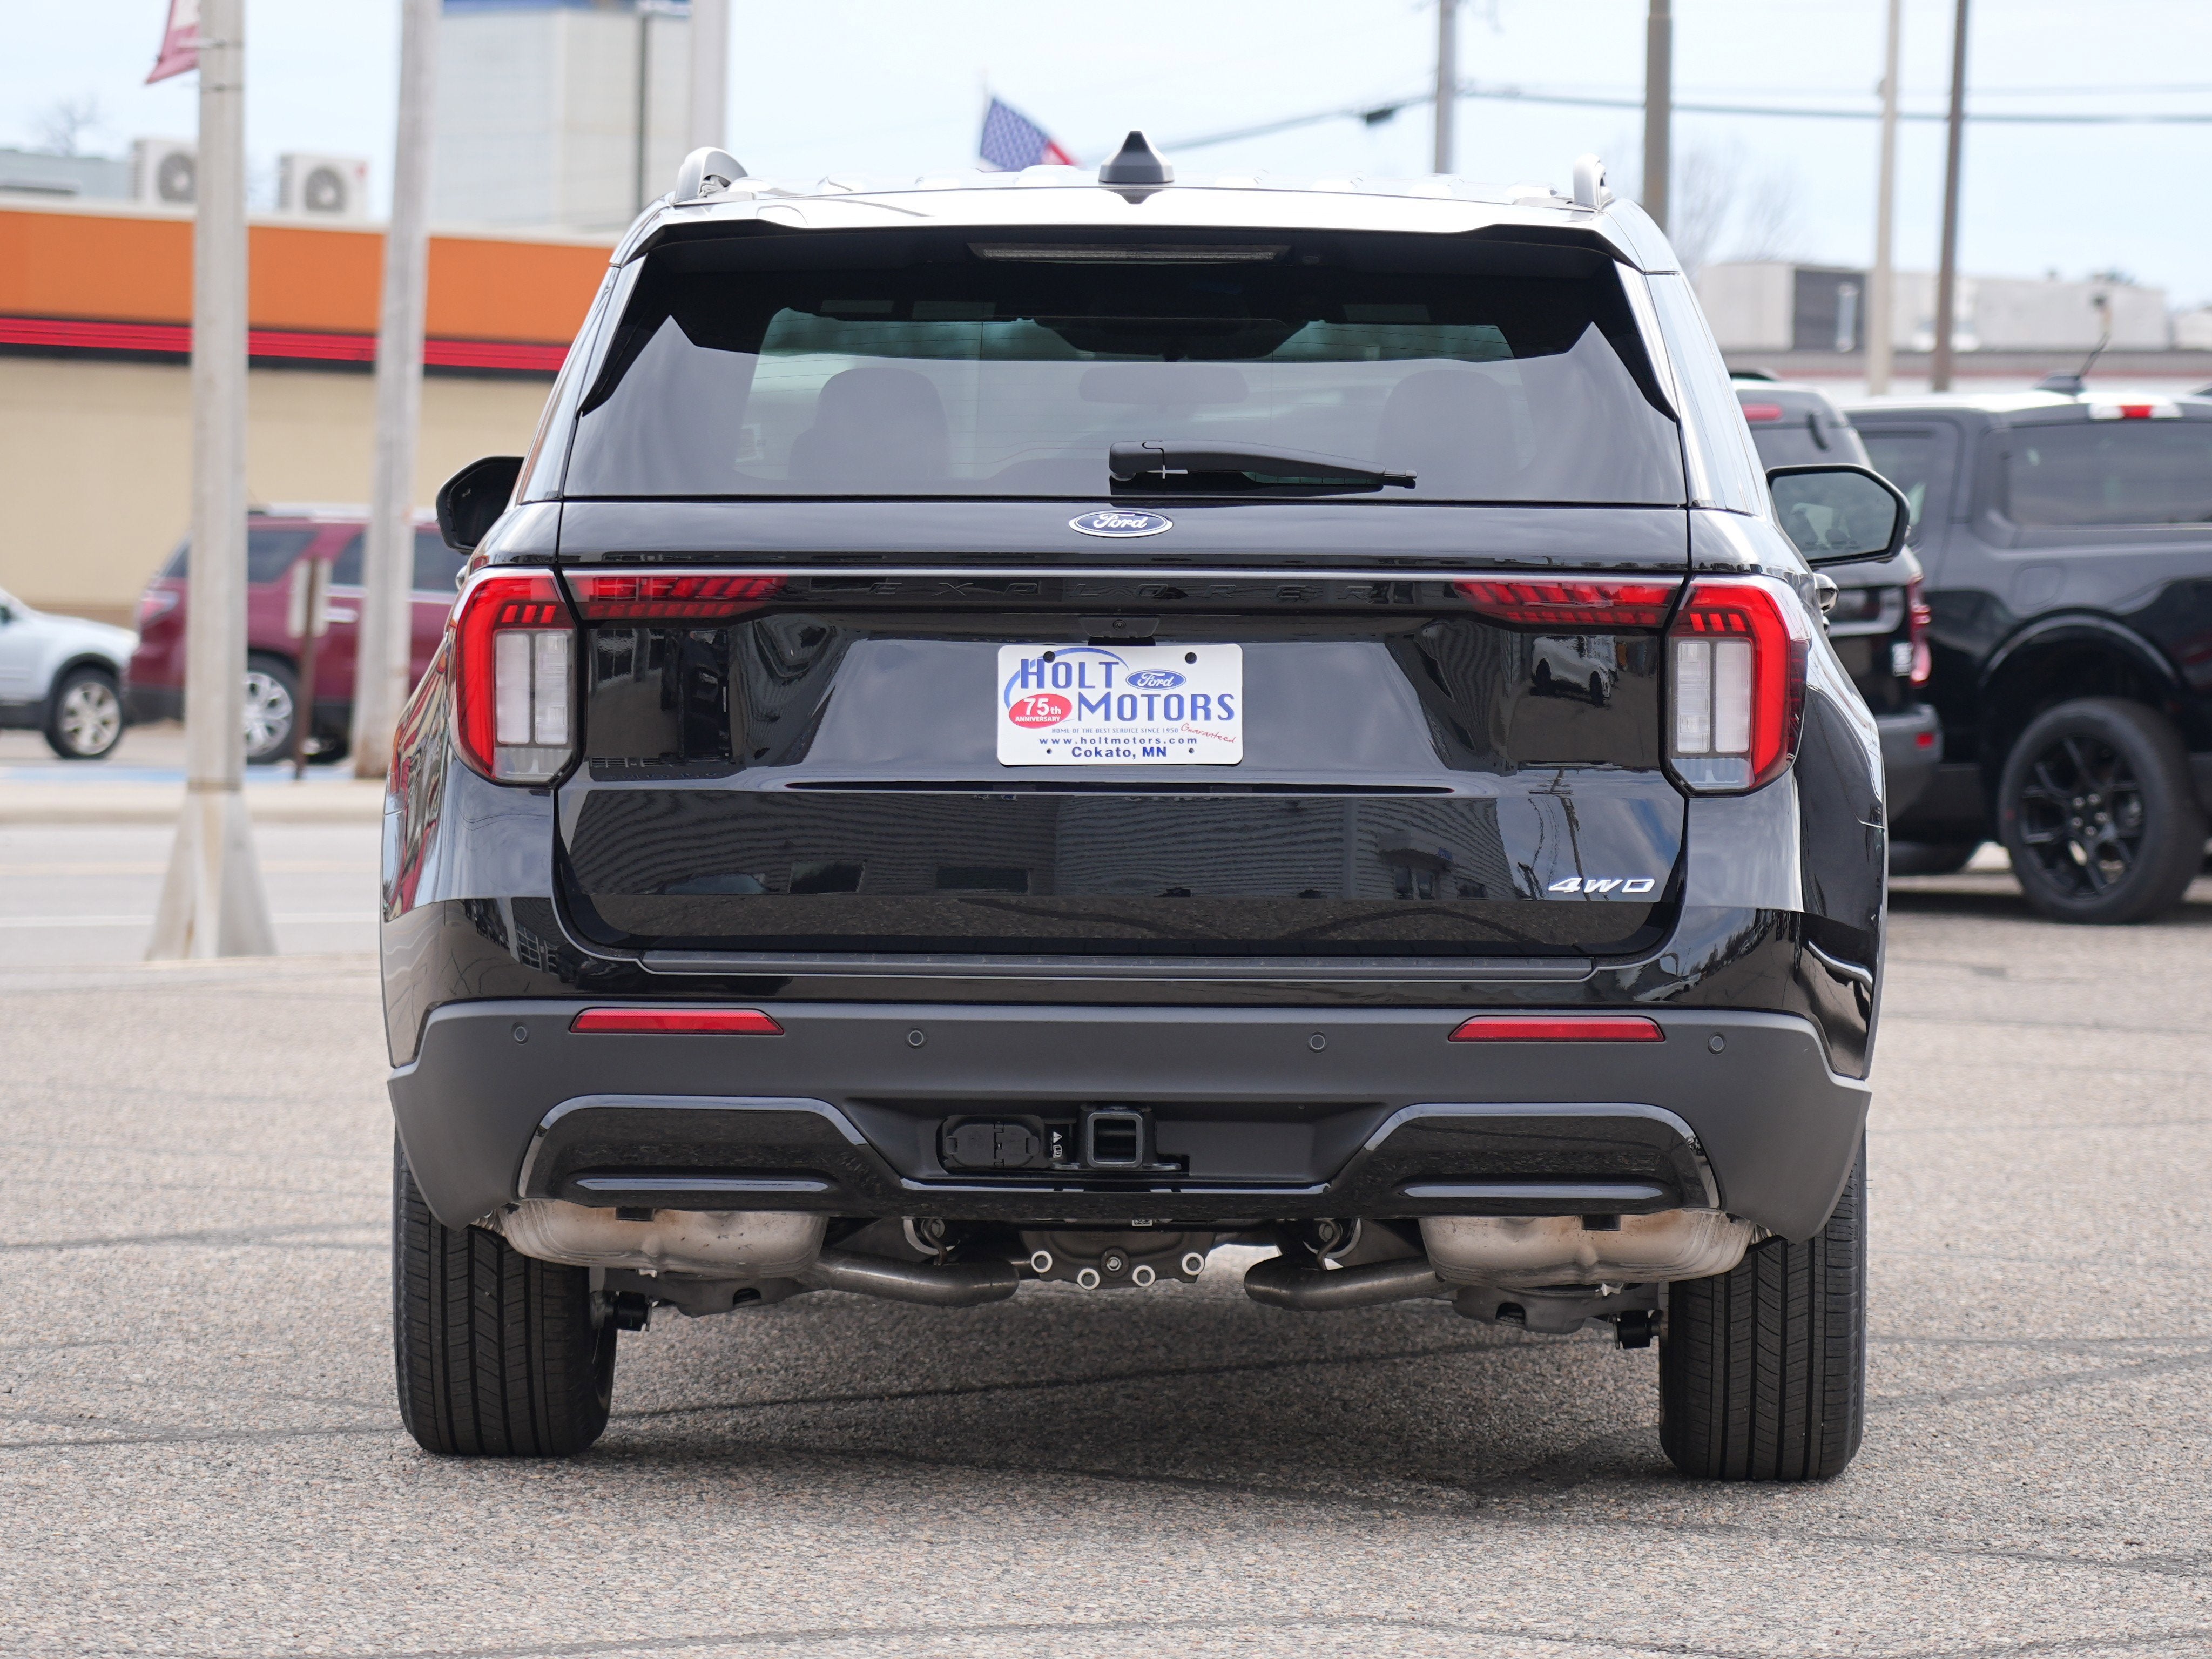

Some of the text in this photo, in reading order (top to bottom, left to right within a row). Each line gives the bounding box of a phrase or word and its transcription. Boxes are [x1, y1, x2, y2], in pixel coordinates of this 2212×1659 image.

[1093, 513, 1149, 528] Ford
[868, 582, 1374, 599] EXPLORER
[1021, 658, 1119, 689] HOLT
[1137, 672, 1174, 689] Ford
[1023, 698, 1062, 716] 75th
[1078, 691, 1235, 721] MOTORS
[1181, 723, 1236, 744] Guaranteed
[1071, 746, 1167, 760] Cokato, MN
[1548, 878, 1655, 893] 4WD
